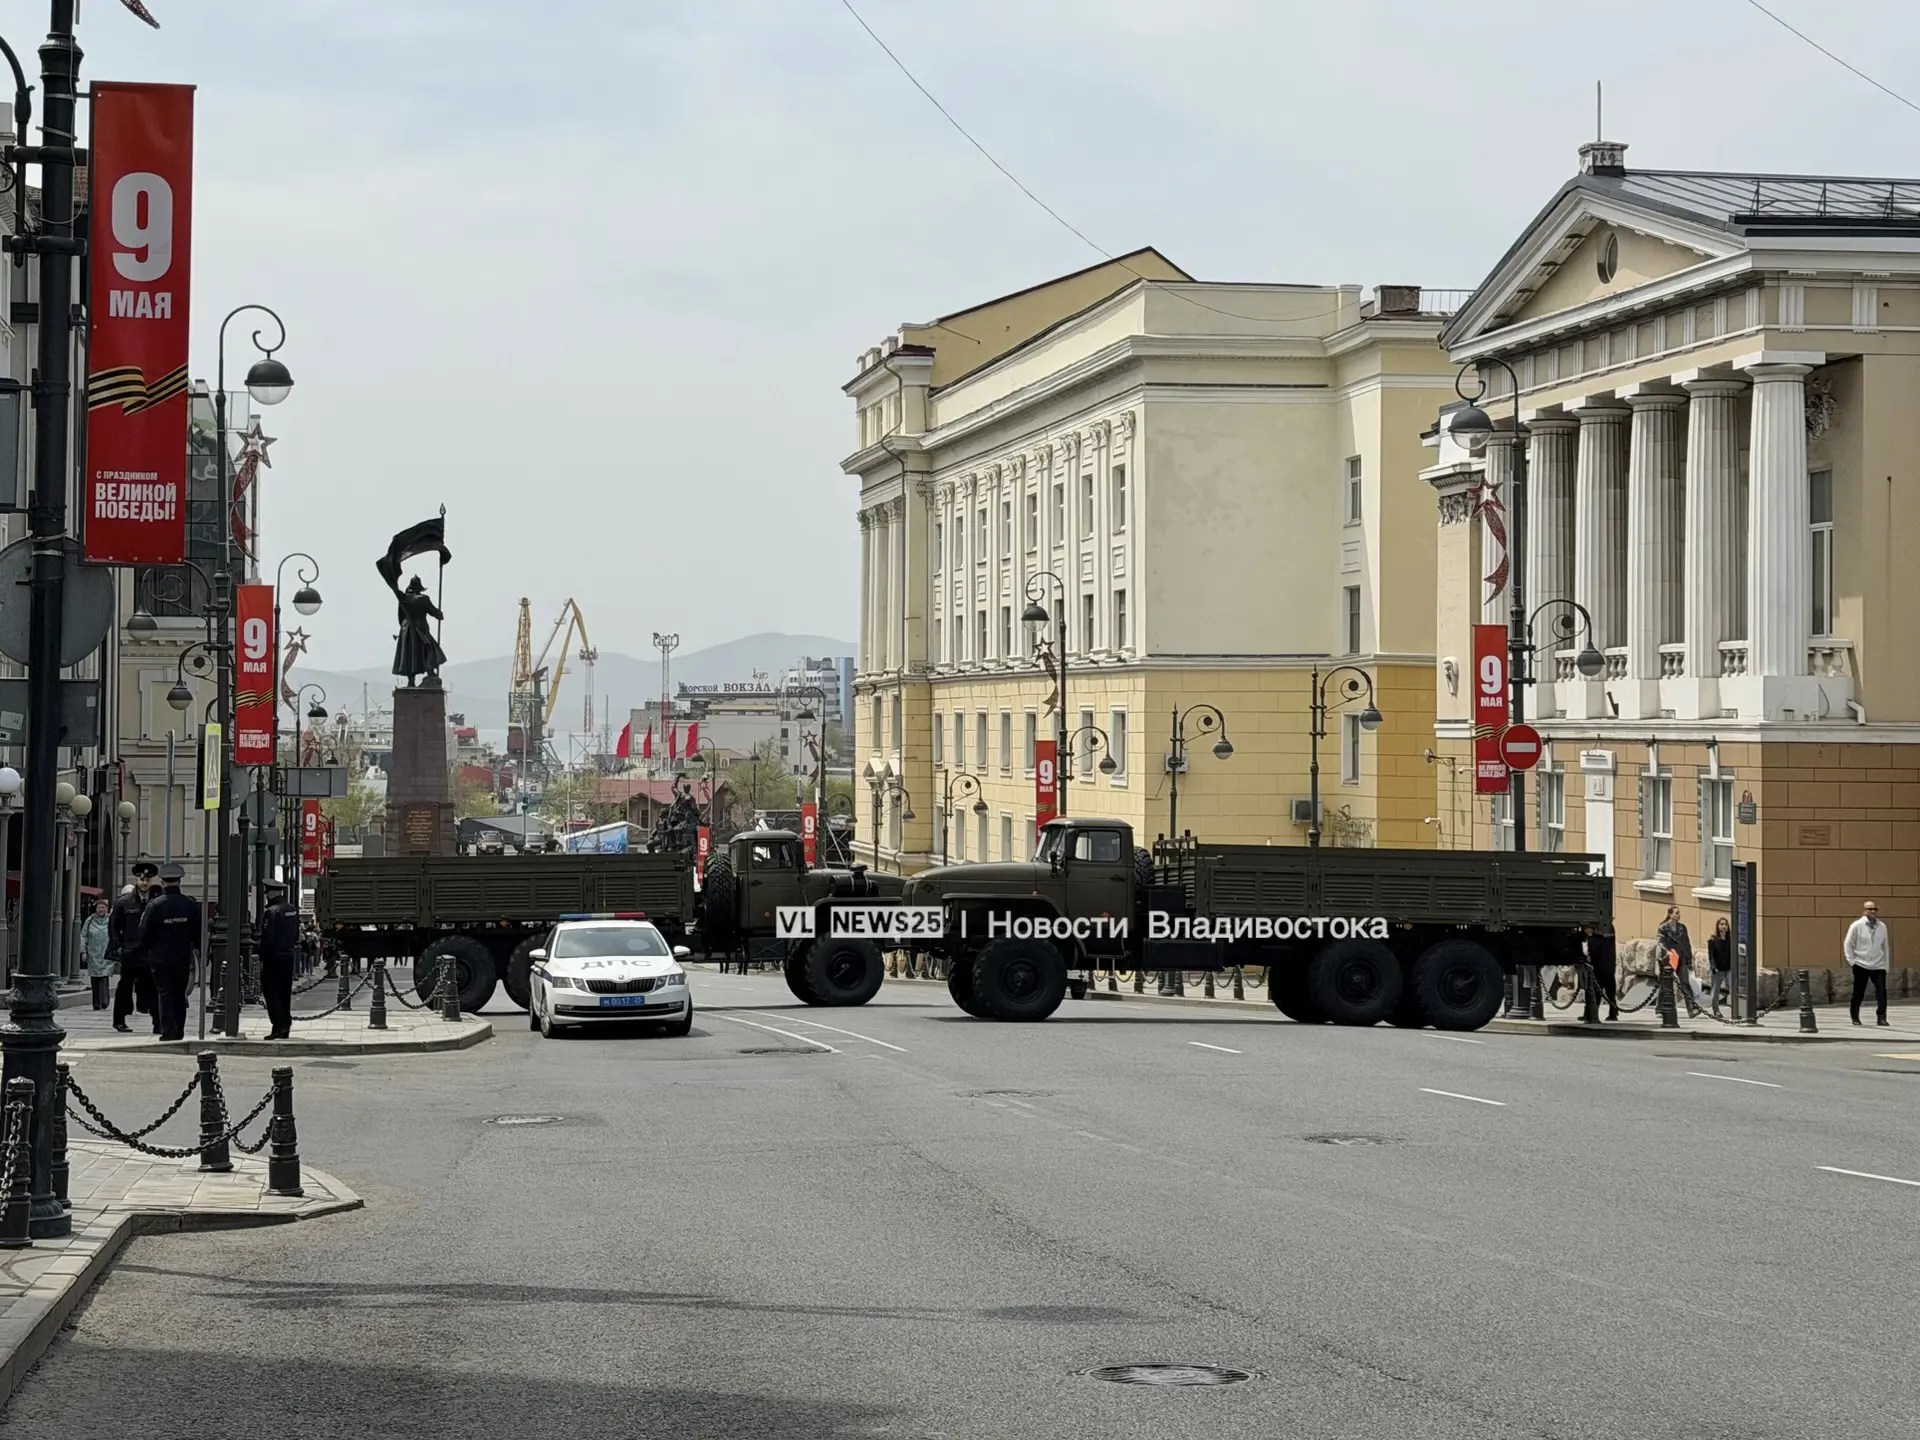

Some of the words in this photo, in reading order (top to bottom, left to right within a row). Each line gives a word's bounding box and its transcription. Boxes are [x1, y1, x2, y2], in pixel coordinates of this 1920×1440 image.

[112, 172, 173, 282] 9
[109, 290, 172, 319] МАЯ
[103, 471, 158, 481] ПРАЗДНИКОМ
[95, 482, 177, 502] ВЕЛИКОЙ
[95, 501, 176, 522] ПОБЕДЫ!
[243, 617, 267, 659] 9
[243, 662, 267, 673] МАЯ
[1480, 655, 1502, 694] 9
[723, 683, 772, 692] ВОКЗАЛ
[1480, 696, 1503, 707] МАЯ
[1039, 760, 1054, 784] 9
[306, 813, 317, 831] 9
[804, 815, 815, 833] 9
[699, 837, 708, 851] 9
[581, 960, 653, 970] ДПС
